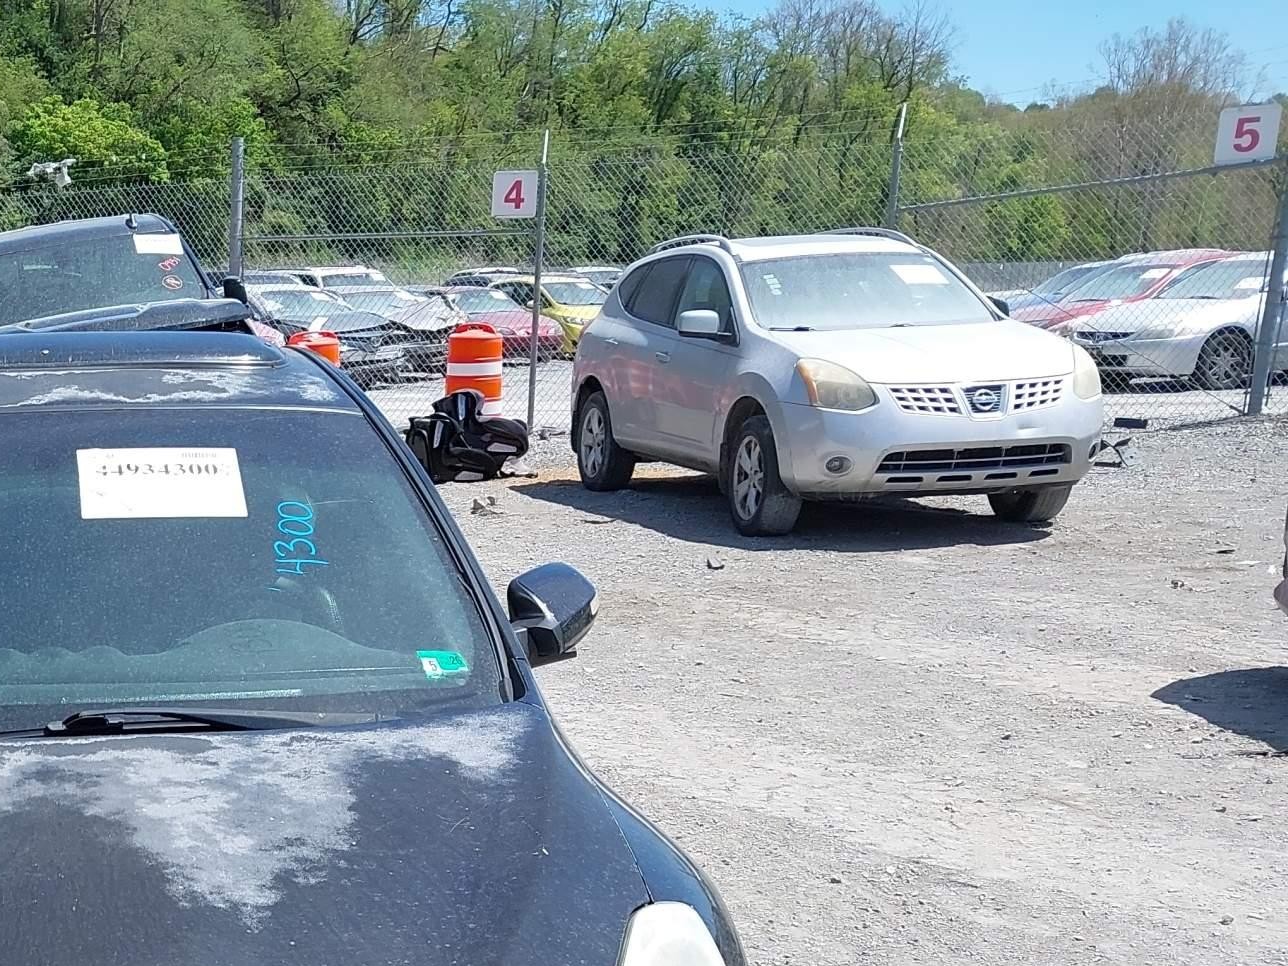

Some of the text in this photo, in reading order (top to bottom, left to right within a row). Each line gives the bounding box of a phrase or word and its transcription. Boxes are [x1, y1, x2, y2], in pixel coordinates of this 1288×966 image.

[1233, 116, 1261, 152] 5
[504, 179, 524, 209] 4
[274, 501, 329, 575] 4300
